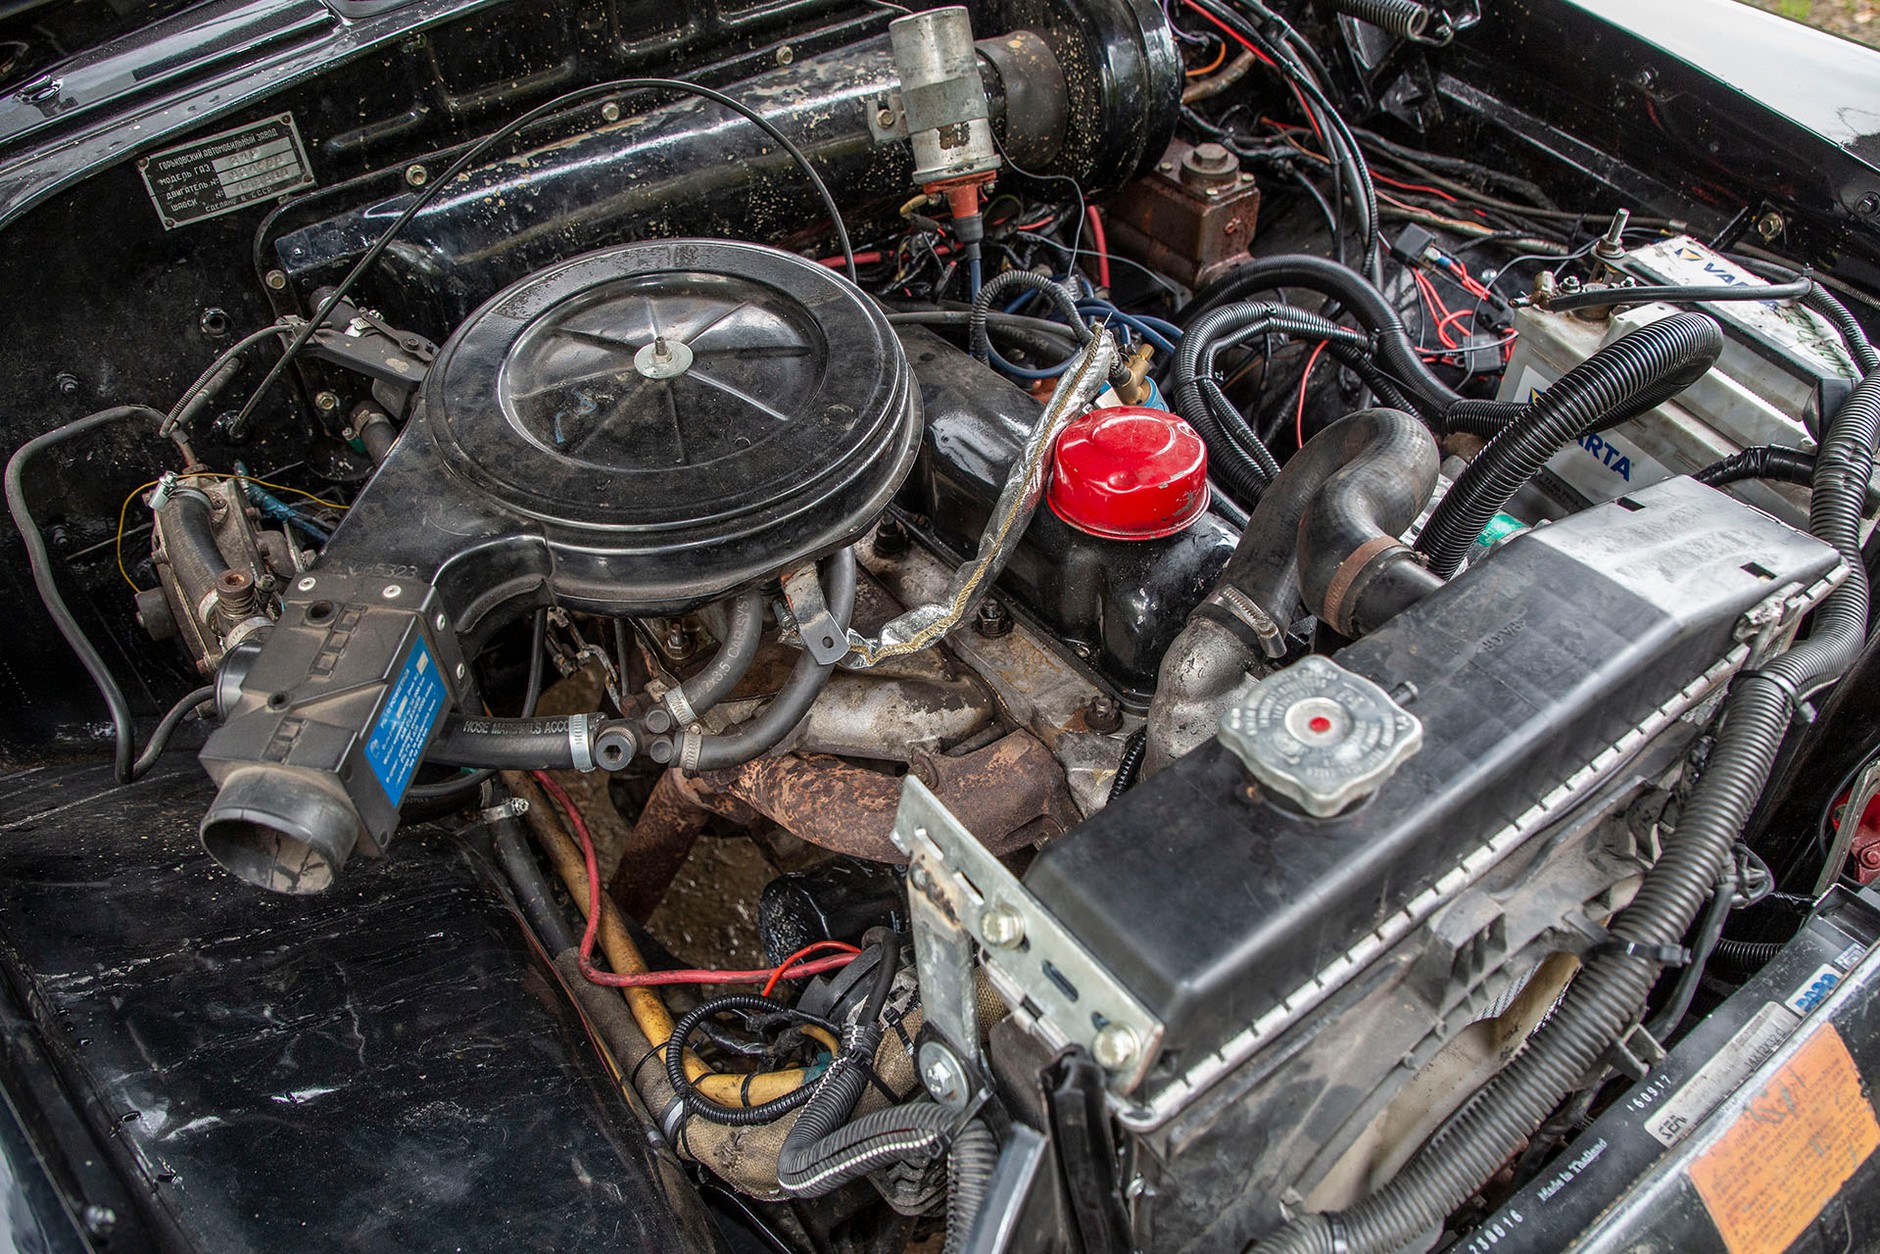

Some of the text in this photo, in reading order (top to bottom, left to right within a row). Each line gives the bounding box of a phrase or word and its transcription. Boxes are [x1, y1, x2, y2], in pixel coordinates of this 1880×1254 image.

[256, 128, 278, 142] ЗАВОД
[160, 171, 192, 185] МОДЕЛЬ
[194, 164, 211, 175] ГАЗ
[166, 181, 208, 200] ДВИГАТЕЛЬ
[1576, 433, 1631, 482] RTA
[463, 720, 490, 734] HOSE
